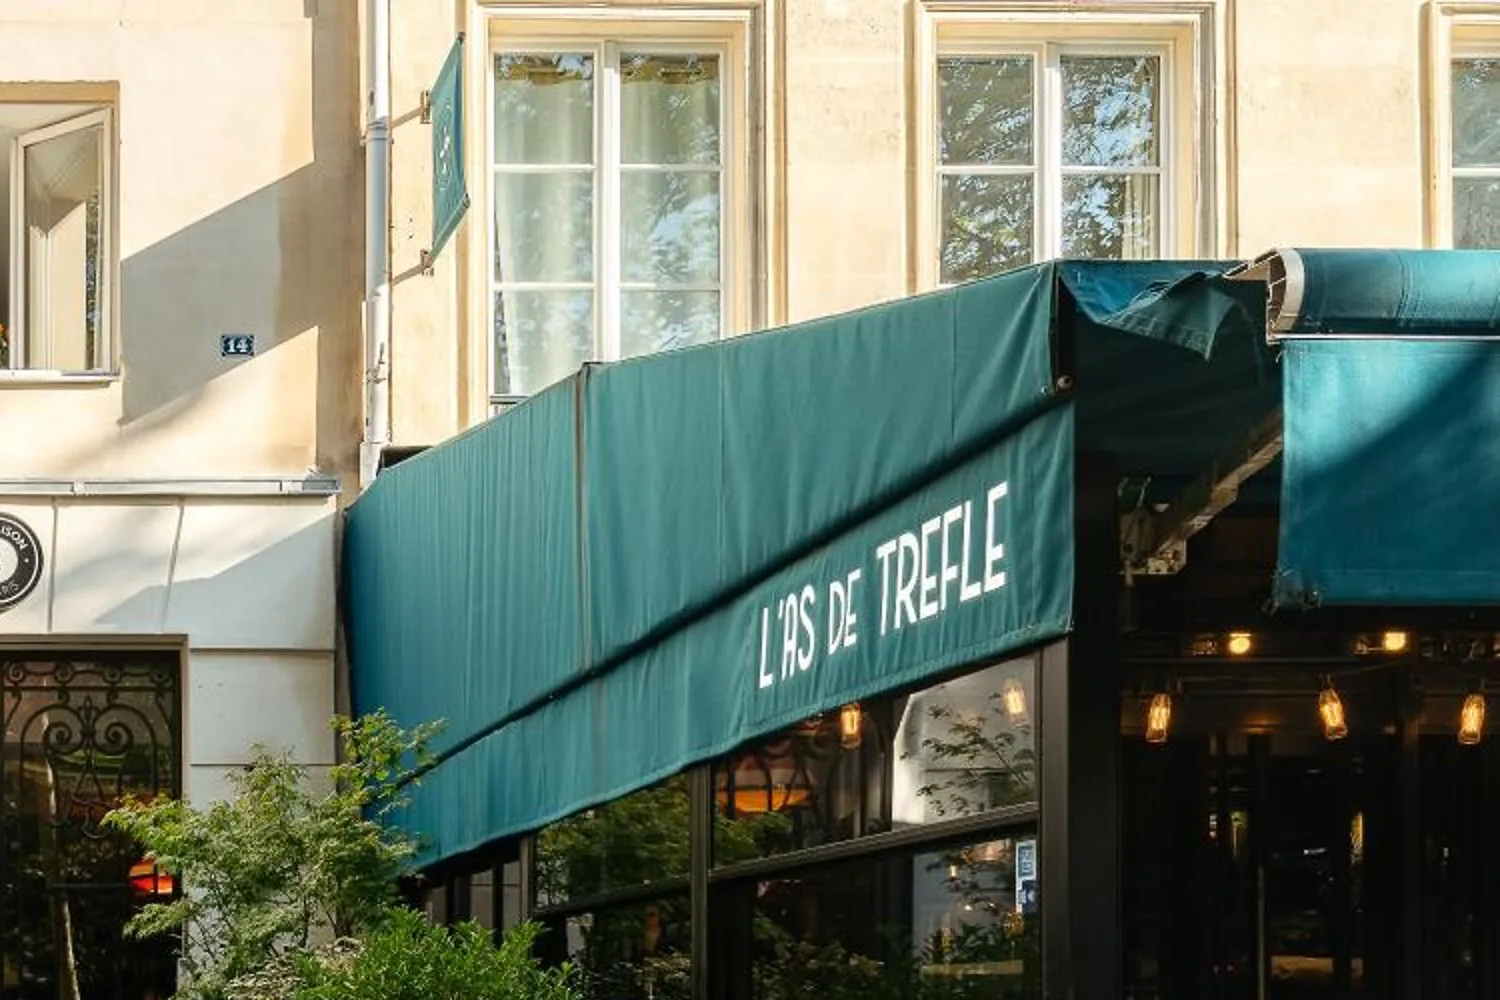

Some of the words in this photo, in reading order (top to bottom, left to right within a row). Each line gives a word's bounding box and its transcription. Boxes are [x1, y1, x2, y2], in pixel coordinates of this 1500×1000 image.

[227, 337, 249, 353] 14
[758, 584, 816, 689] L'AS
[827, 569, 861, 656] DE
[875, 480, 1009, 636] TREFLE
